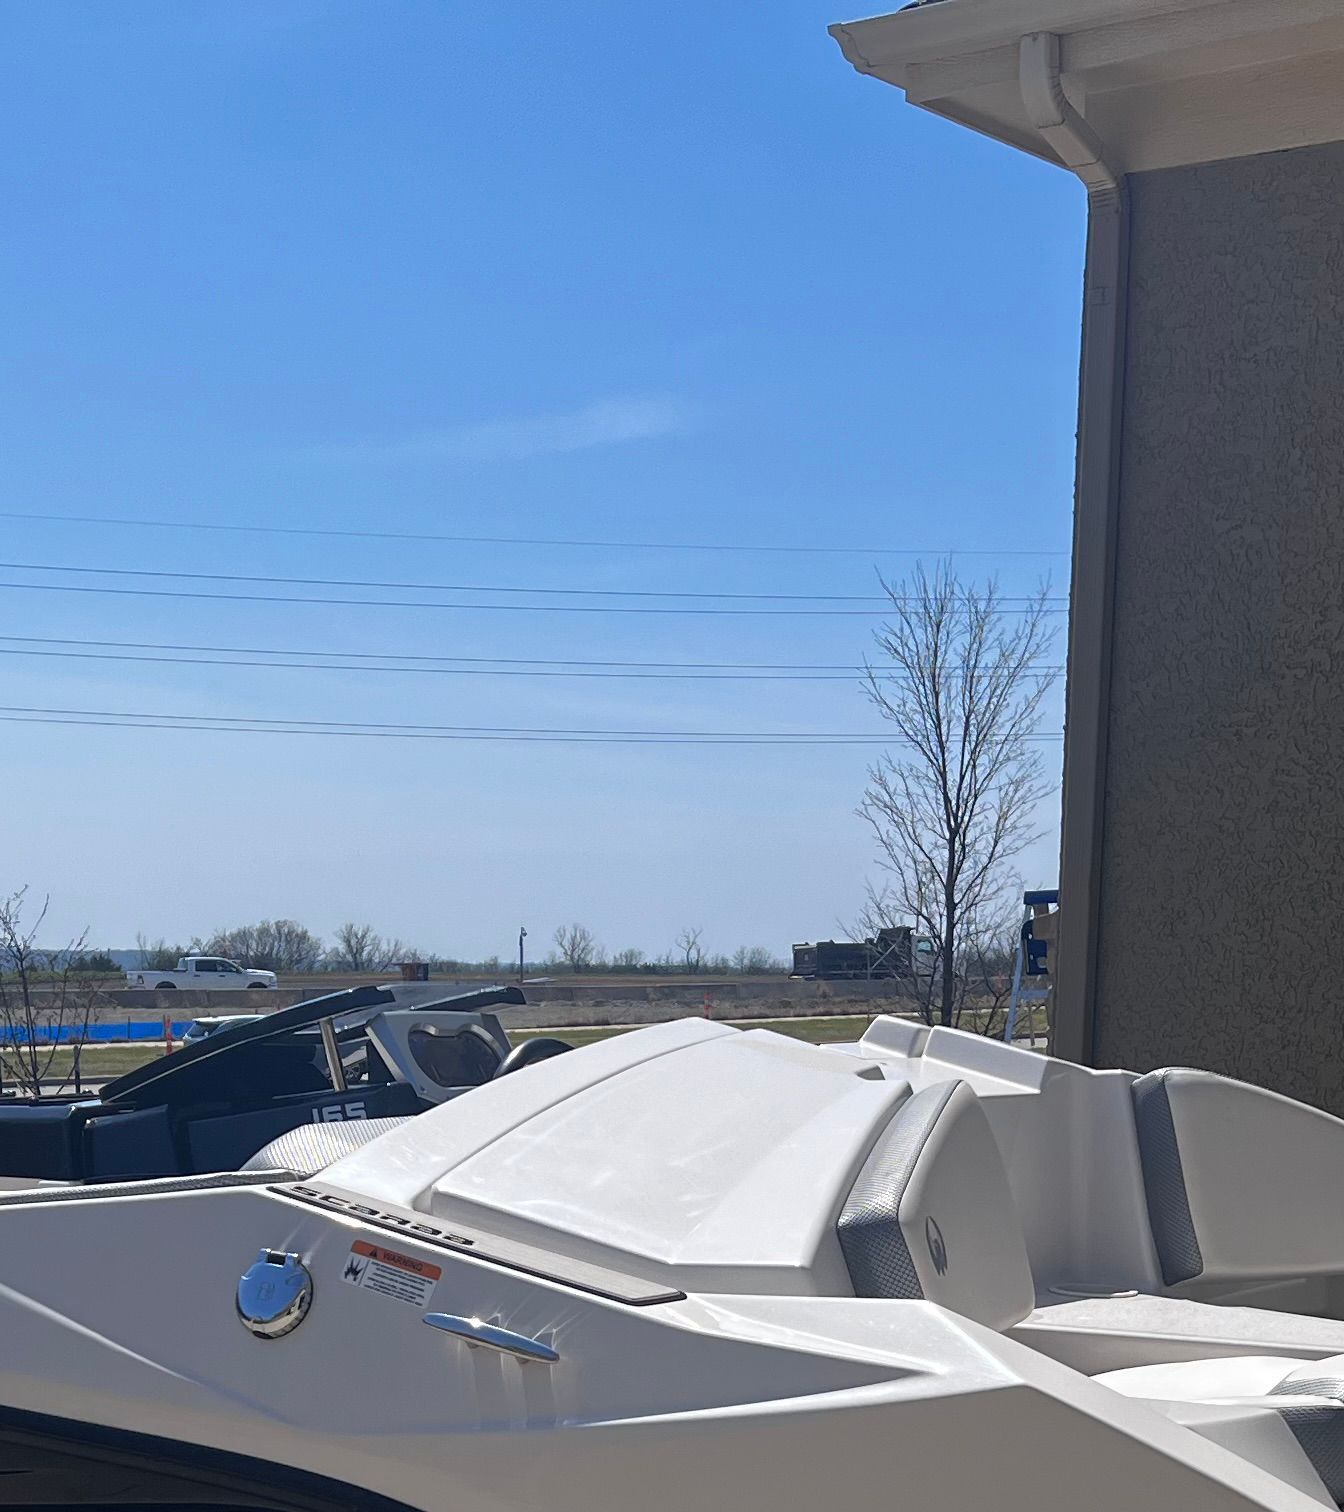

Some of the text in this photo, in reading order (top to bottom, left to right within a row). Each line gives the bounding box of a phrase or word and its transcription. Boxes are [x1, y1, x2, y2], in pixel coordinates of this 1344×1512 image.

[312, 1102, 367, 1123] 165
[291, 1186, 475, 1246] SCARAB
[383, 1249, 424, 1272] WARNING
